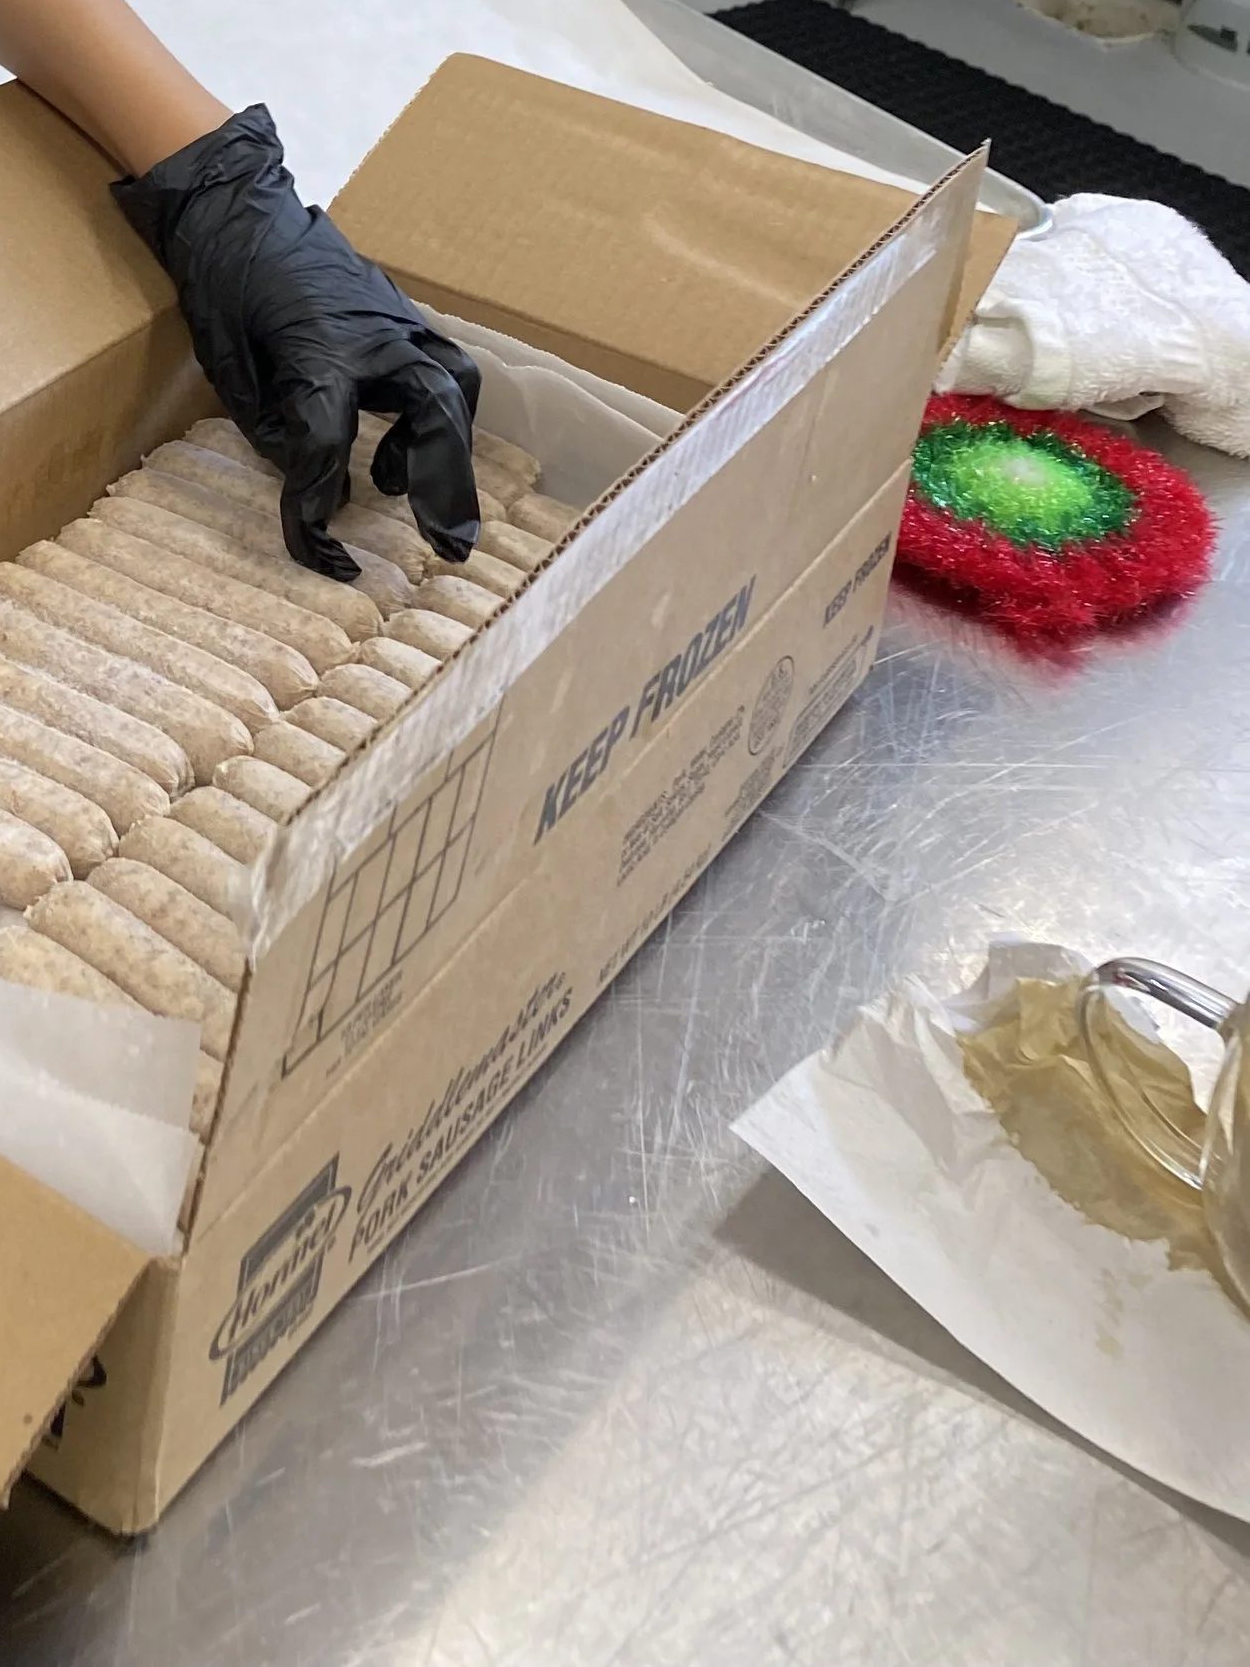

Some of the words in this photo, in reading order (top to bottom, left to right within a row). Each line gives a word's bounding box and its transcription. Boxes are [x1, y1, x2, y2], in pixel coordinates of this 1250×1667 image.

[533, 705, 631, 847] KEEP
[629, 573, 757, 742] FROZEN
[348, 1171, 414, 1264] PORK
[416, 1054, 514, 1184] SAUSAGE
[516, 986, 573, 1069] LINKS
[228, 1199, 338, 1344] Hormel
